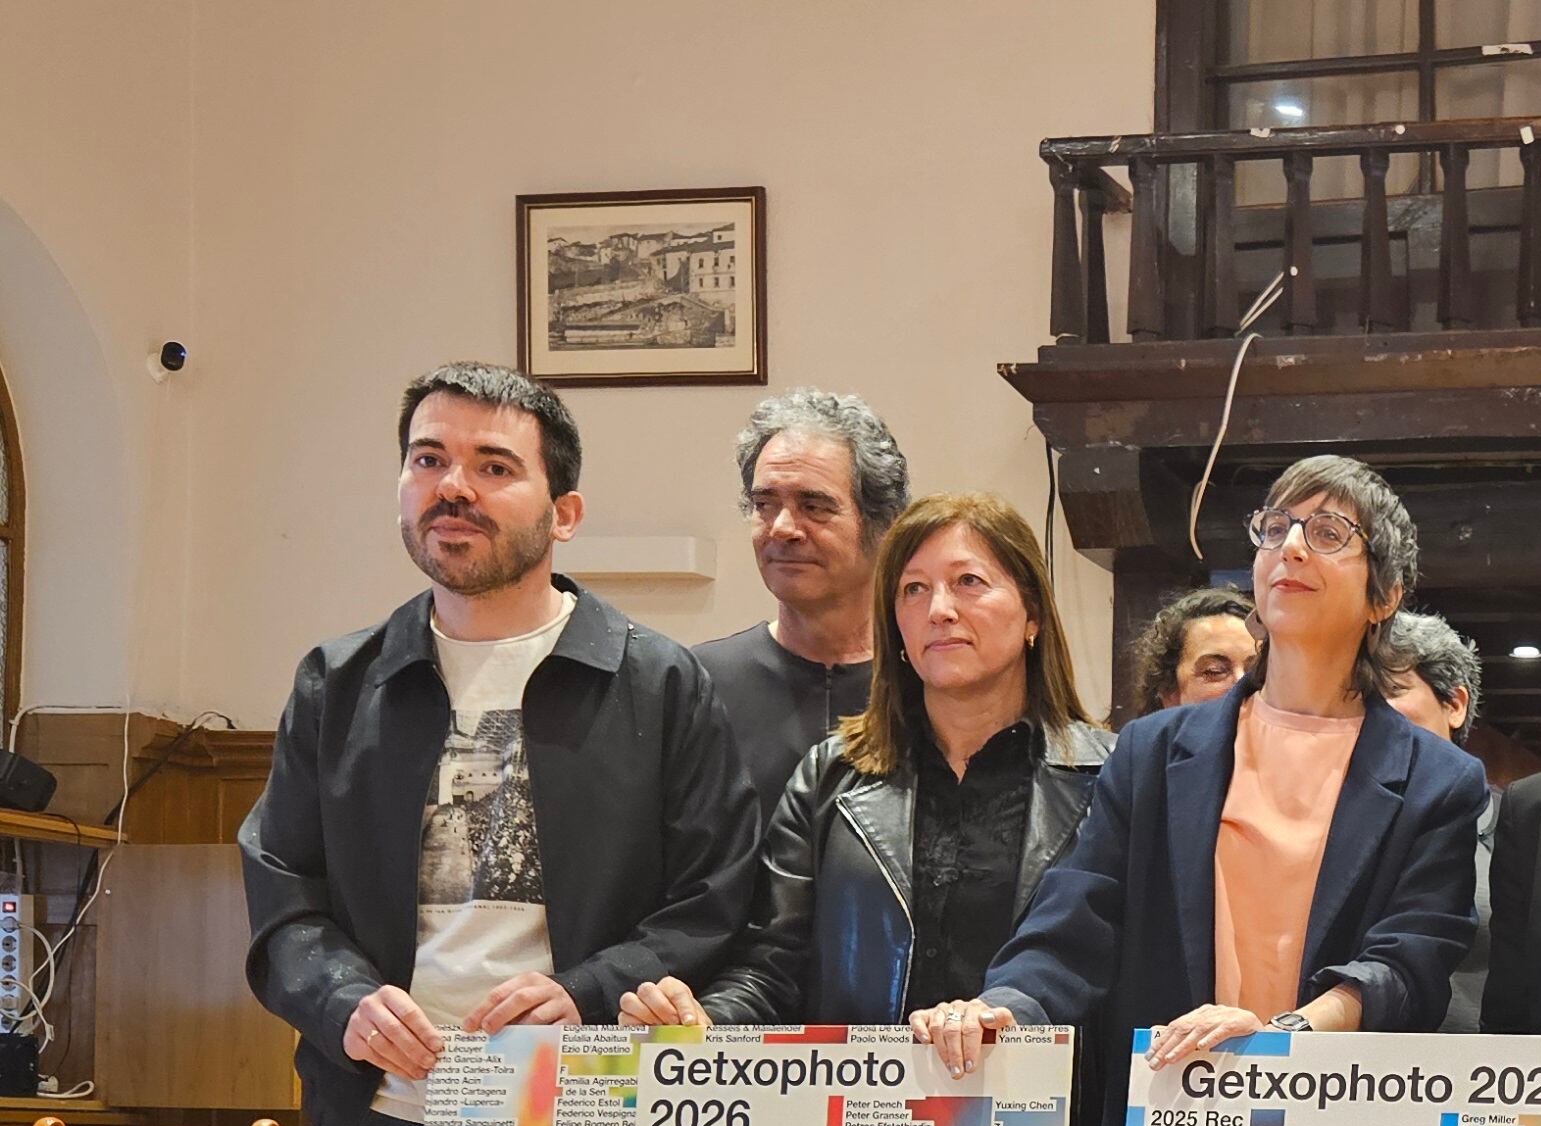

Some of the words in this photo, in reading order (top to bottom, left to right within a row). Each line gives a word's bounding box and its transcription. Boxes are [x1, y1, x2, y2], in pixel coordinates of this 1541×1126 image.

[653, 1048, 905, 1094] Getxophoto
[1181, 1059, 1452, 1109] Getxophoto
[845, 1099, 871, 1108] Peter
[872, 1099, 903, 1108] Dench
[1028, 1100, 1054, 1109] Chen
[1150, 1109, 1197, 1126] 2025
